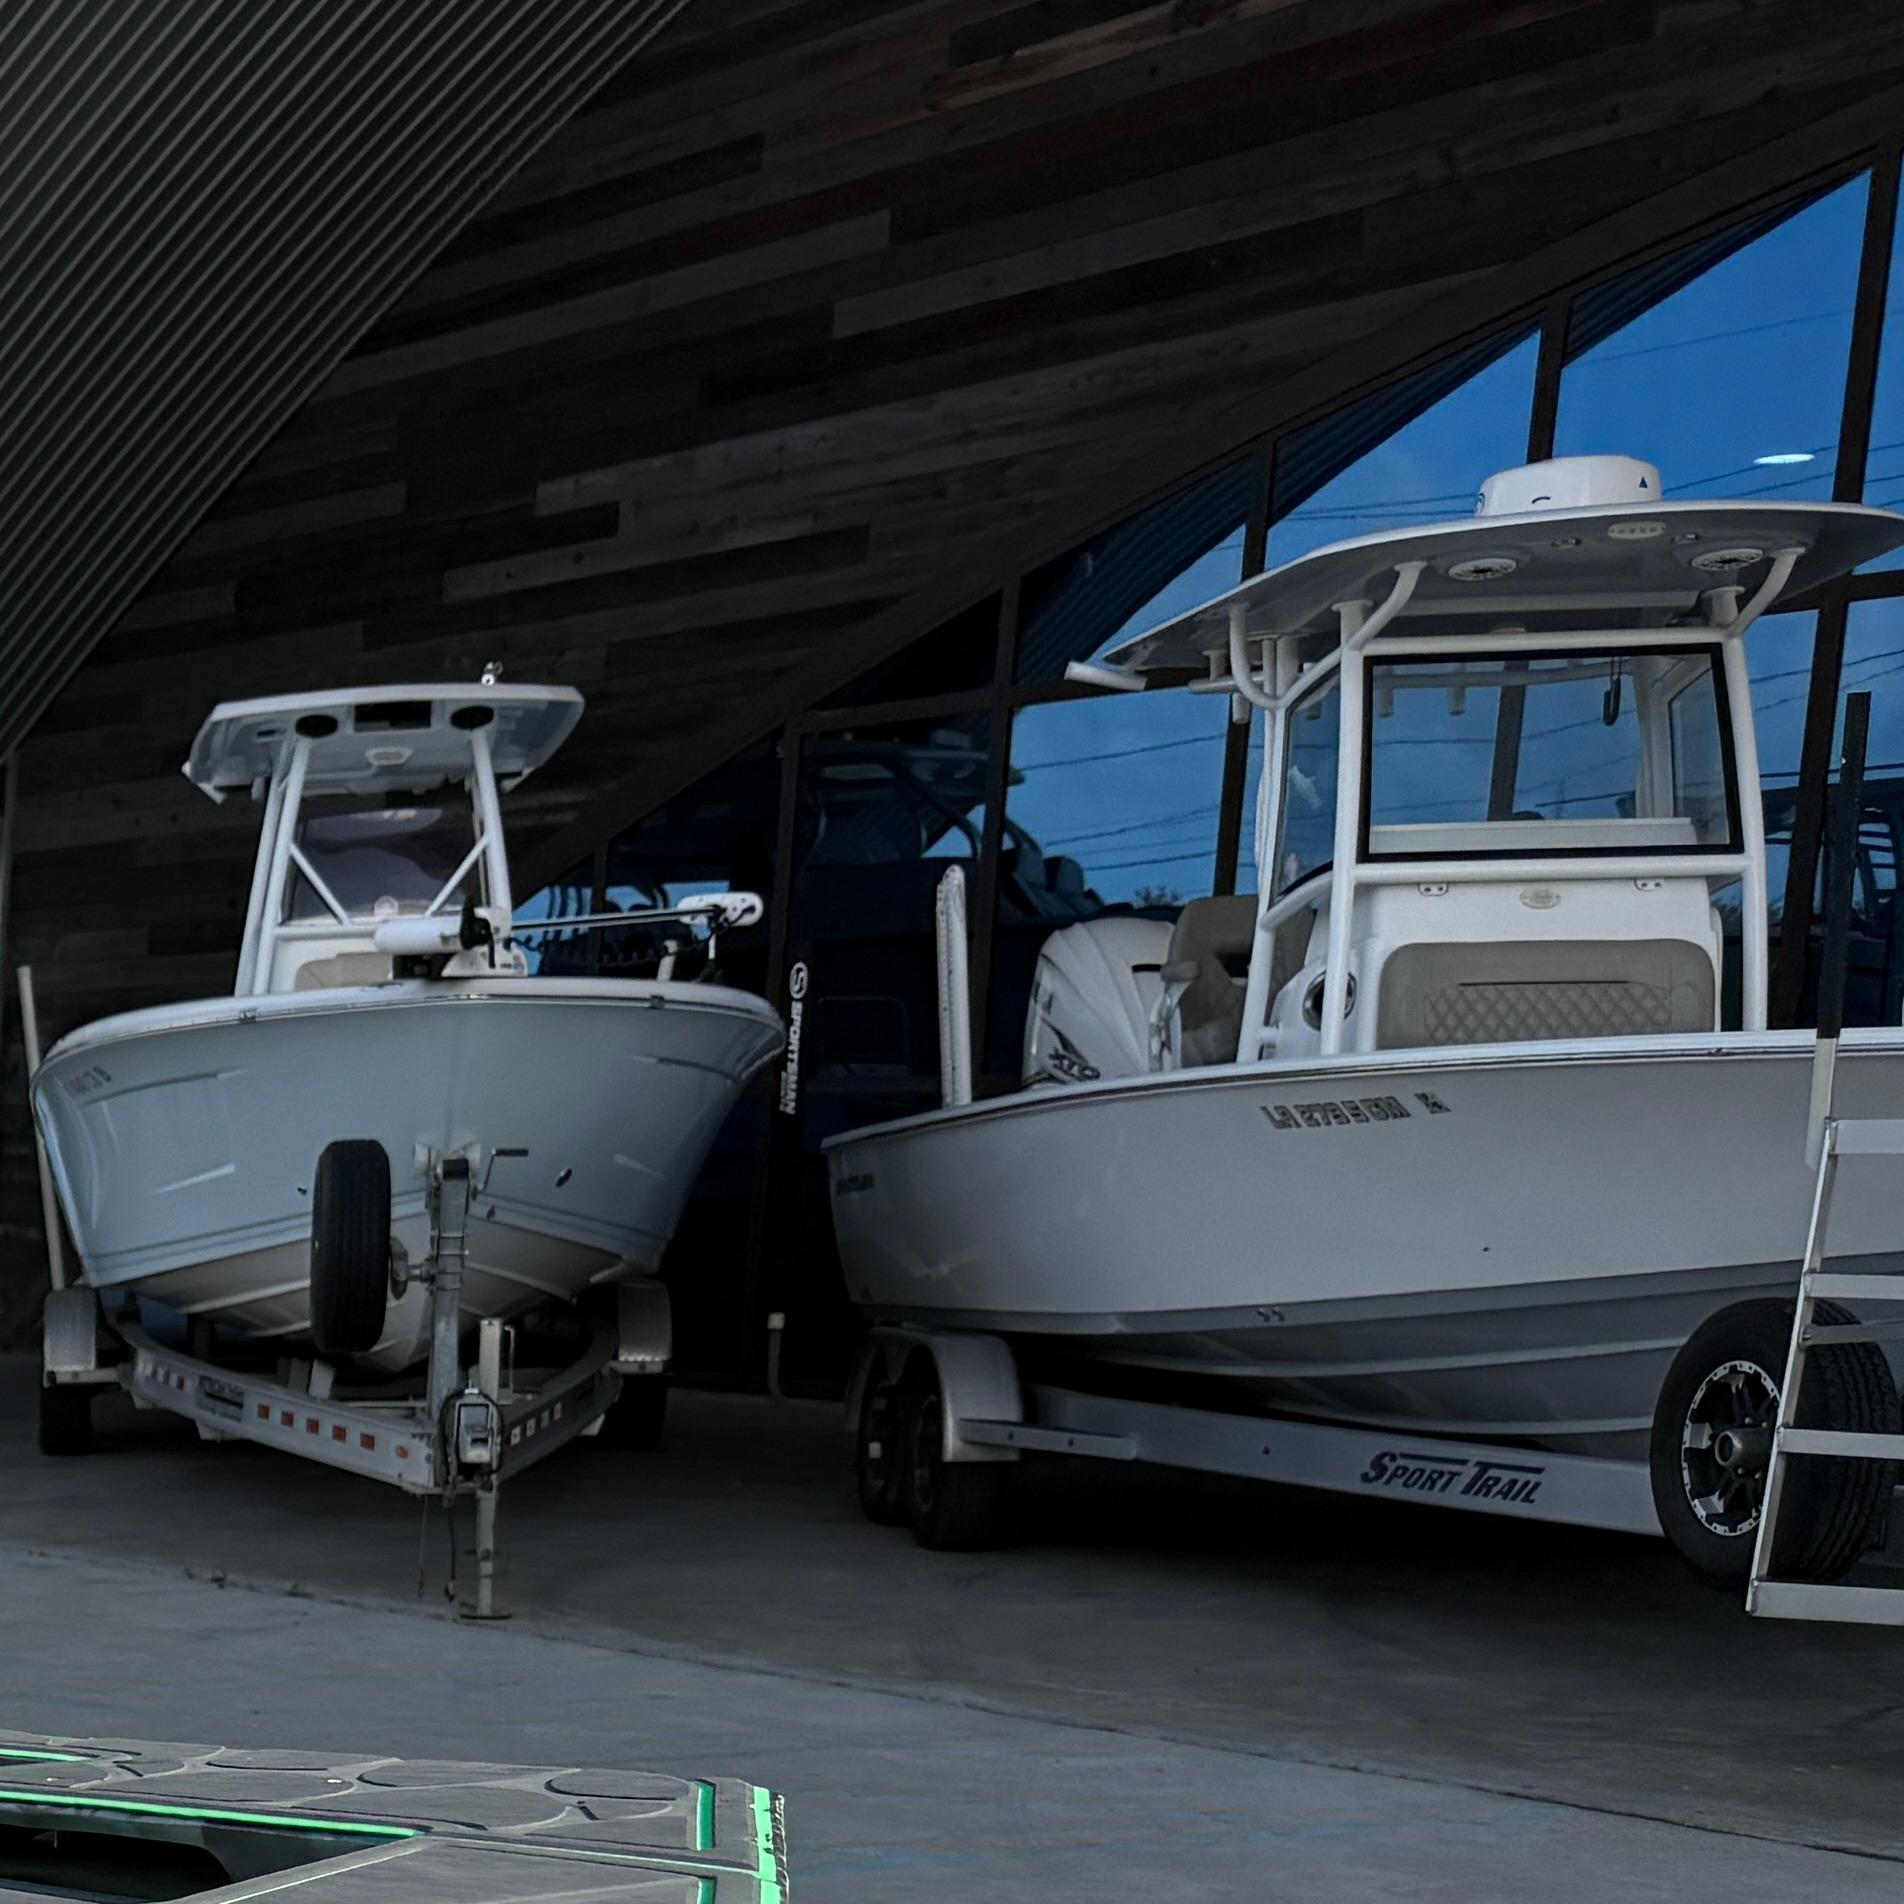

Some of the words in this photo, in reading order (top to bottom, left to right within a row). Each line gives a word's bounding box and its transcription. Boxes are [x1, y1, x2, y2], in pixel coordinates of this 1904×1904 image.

[784, 1000, 803, 1114] SPORTSMAN
[1360, 1452, 1469, 1493] SPORT
[1459, 1460, 1545, 1504] TRAIL
